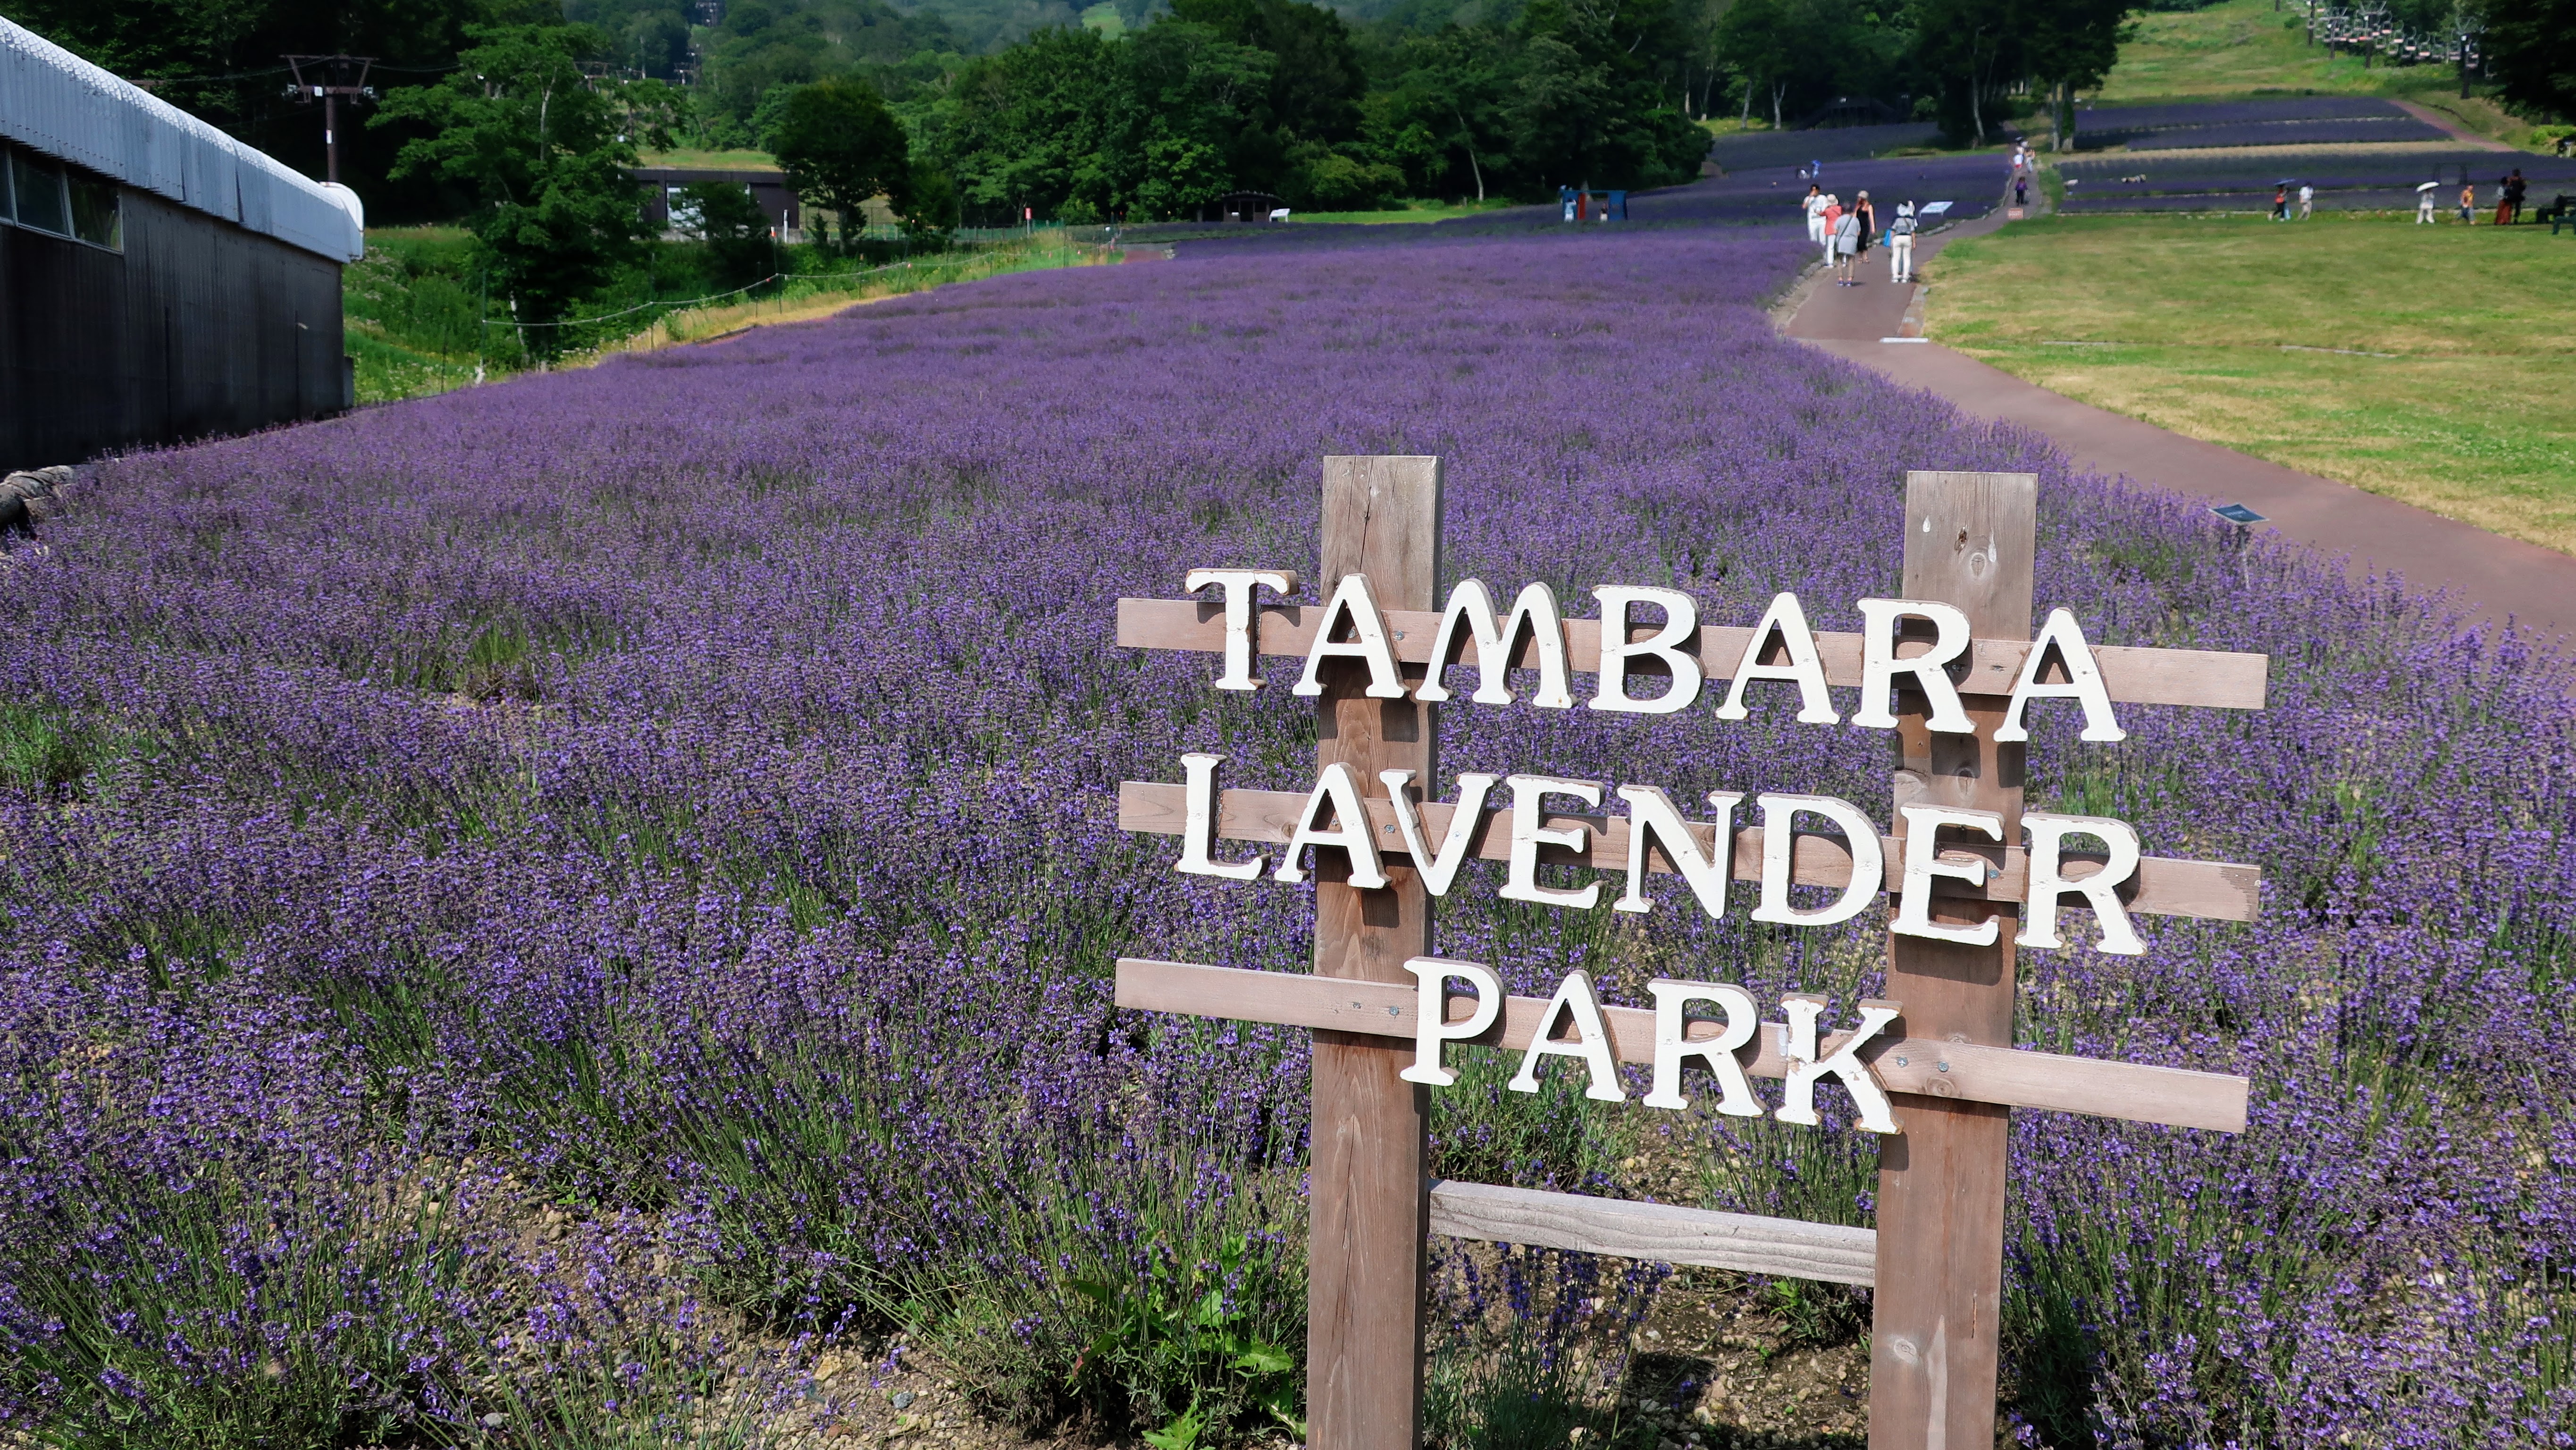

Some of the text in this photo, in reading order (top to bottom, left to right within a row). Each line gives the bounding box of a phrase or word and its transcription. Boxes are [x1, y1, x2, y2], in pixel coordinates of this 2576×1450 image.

[1185, 568, 2127, 742] TAMBARA
[1176, 754, 2148, 956] LAVENDER
[1400, 956, 1903, 1135] PARK
